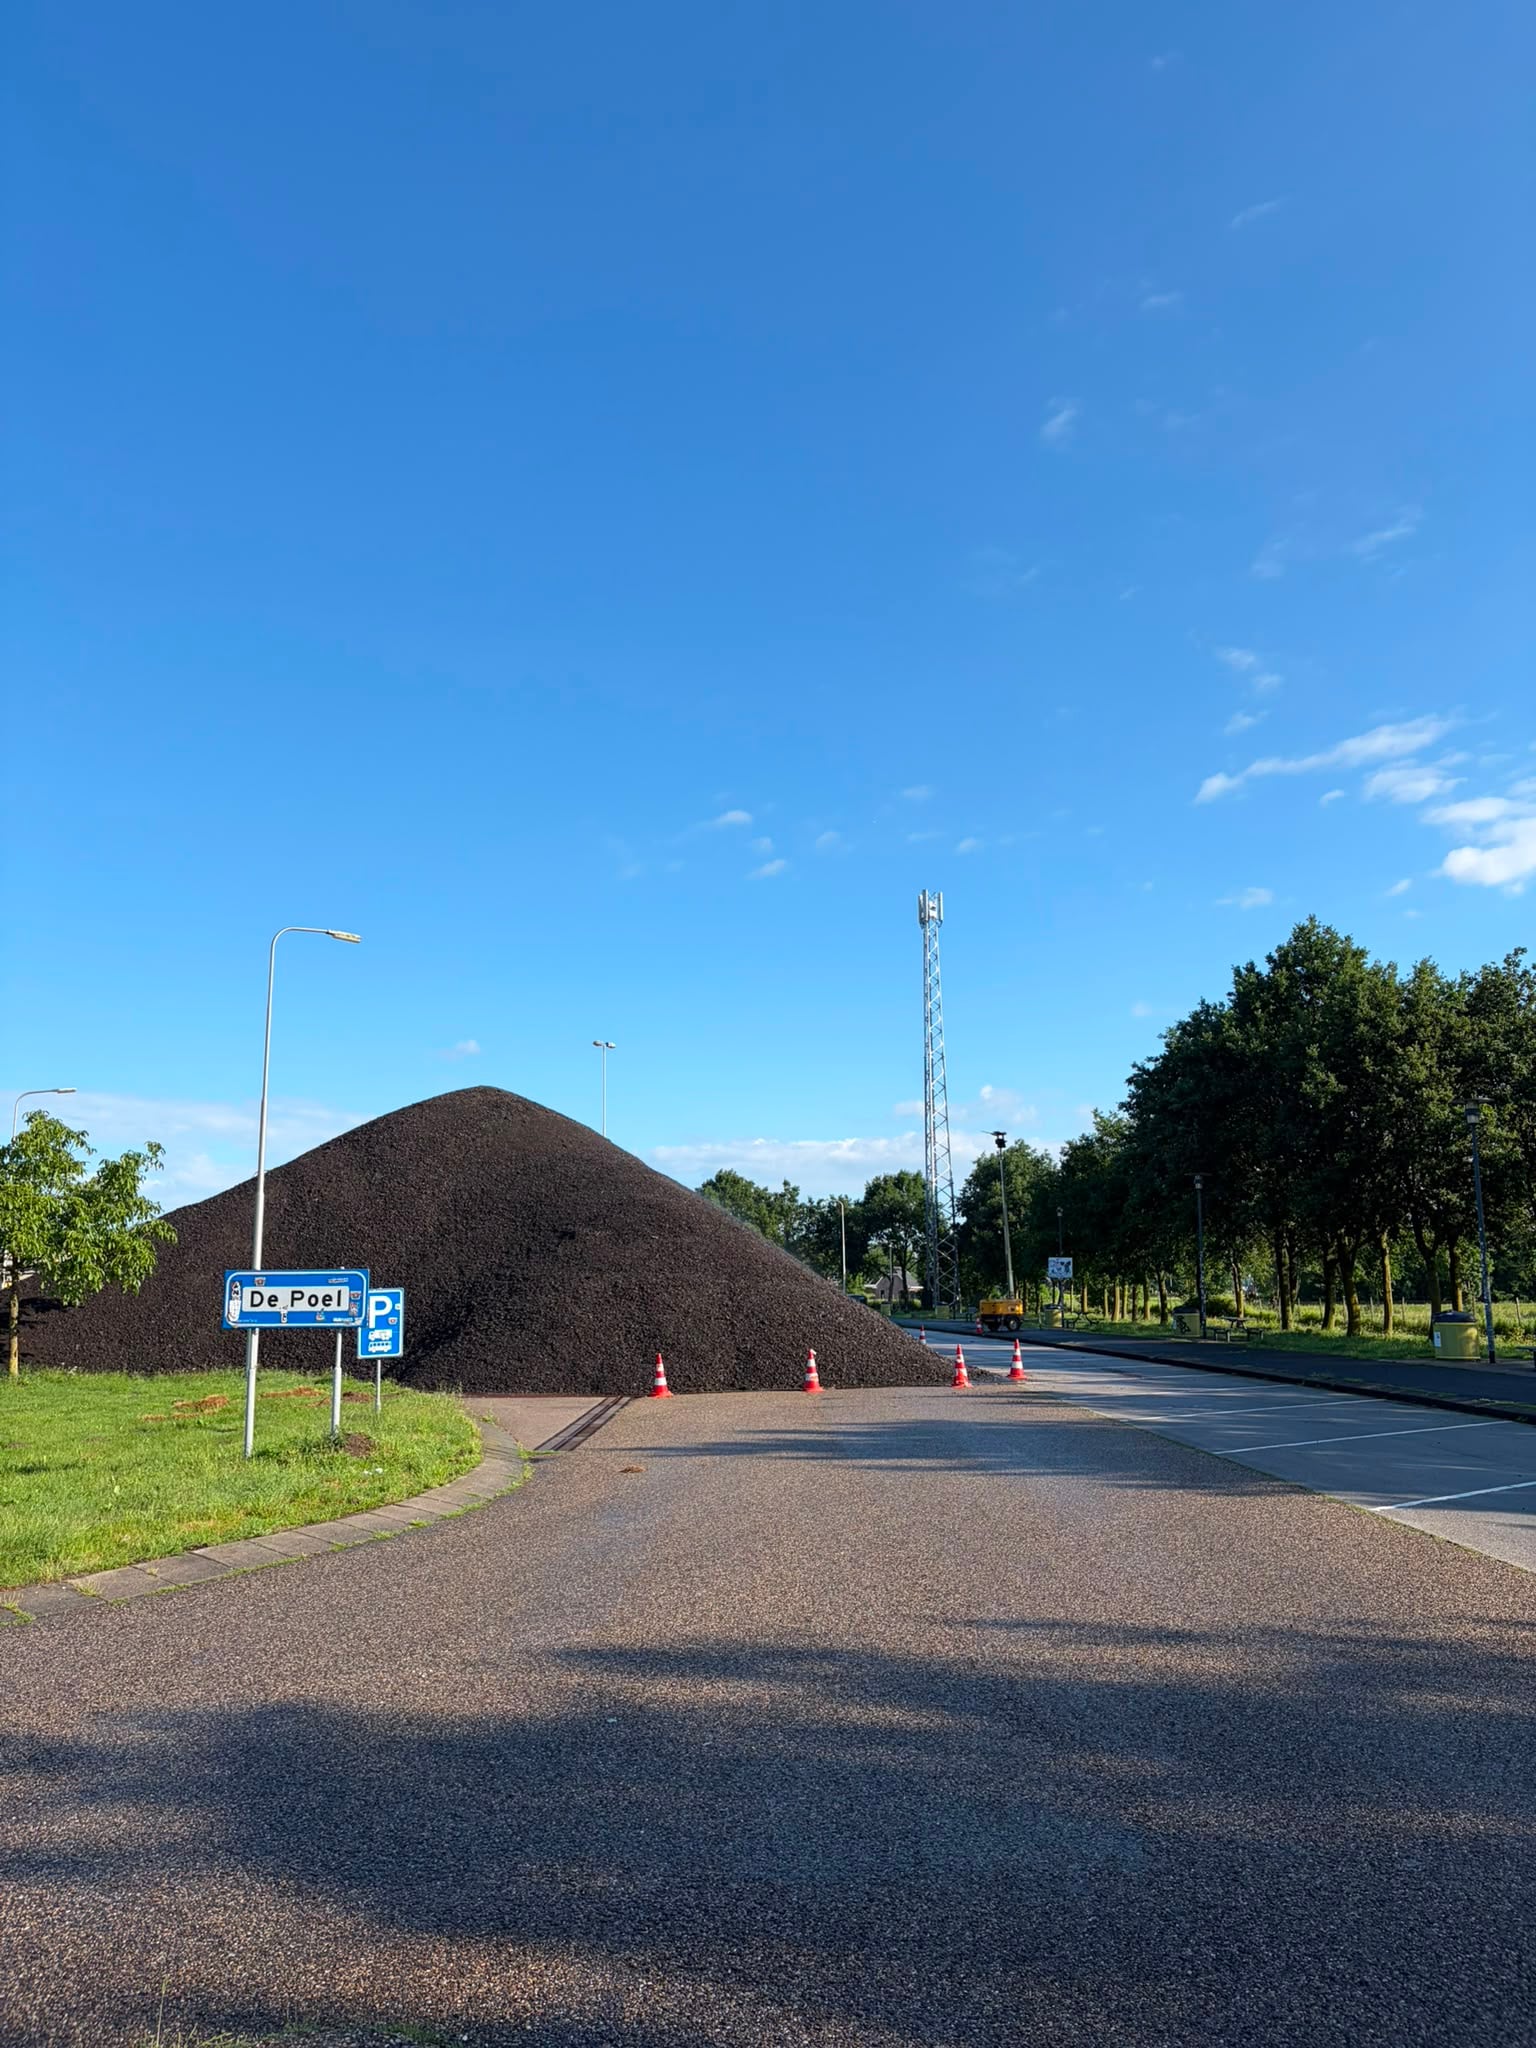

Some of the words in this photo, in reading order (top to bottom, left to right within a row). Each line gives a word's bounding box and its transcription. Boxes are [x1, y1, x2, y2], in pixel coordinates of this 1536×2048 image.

[250, 1290, 279, 1308] De
[290, 1289, 342, 1308] Poel
[369, 1295, 393, 1329] P
